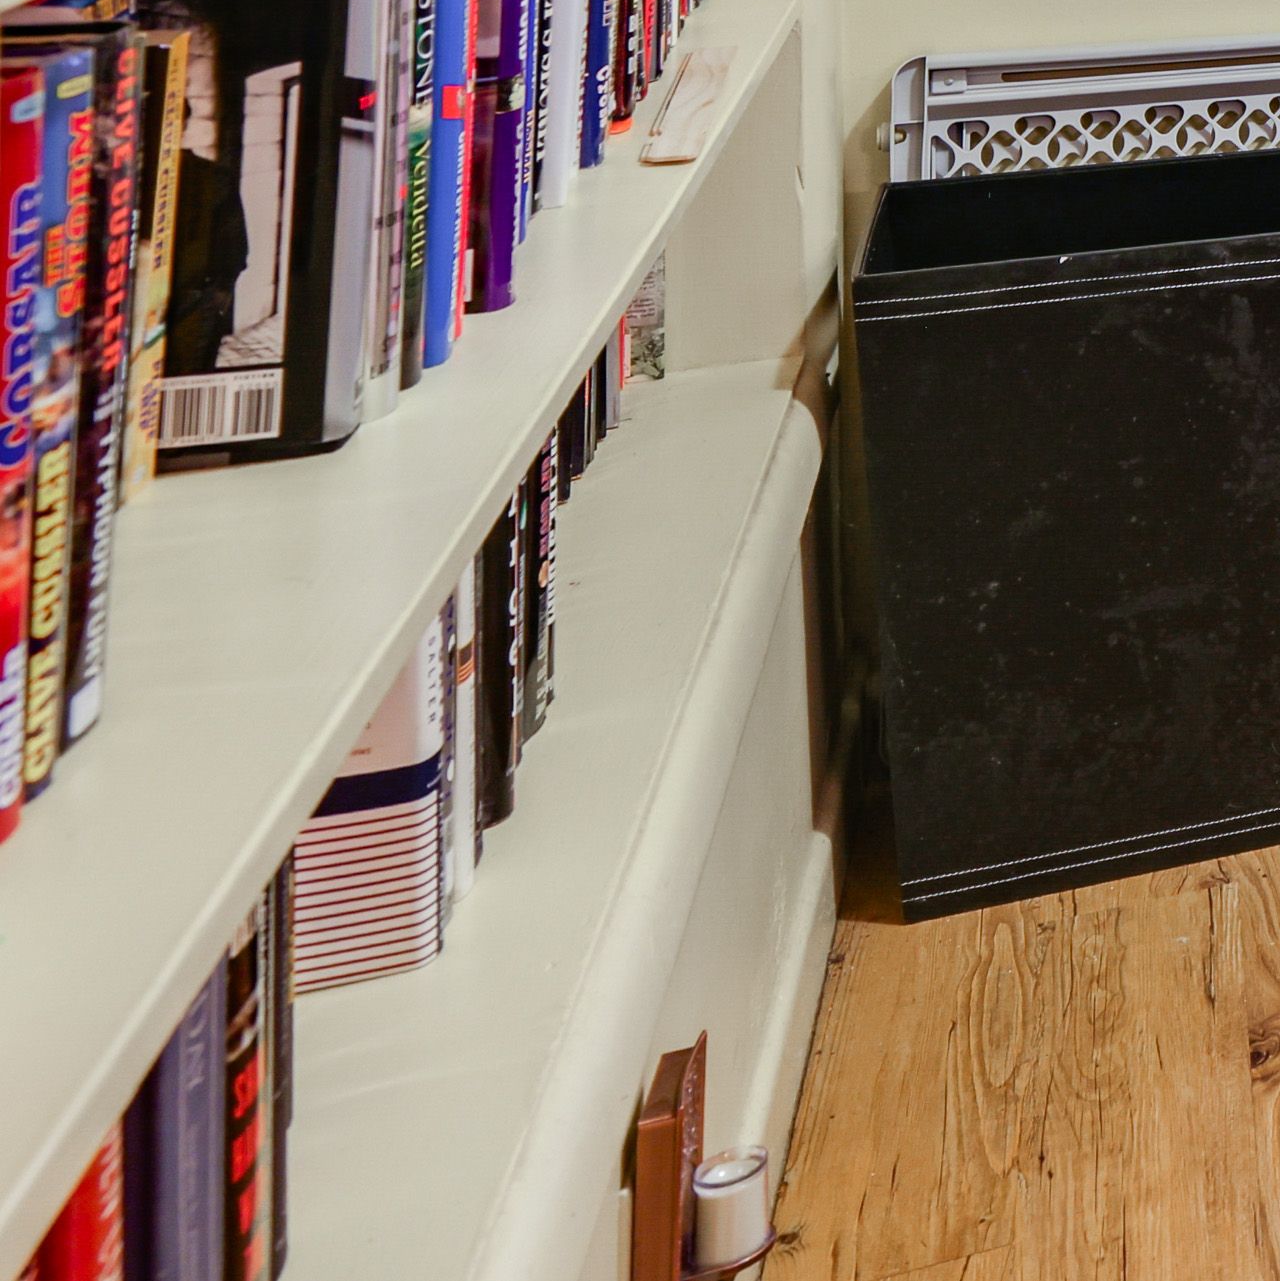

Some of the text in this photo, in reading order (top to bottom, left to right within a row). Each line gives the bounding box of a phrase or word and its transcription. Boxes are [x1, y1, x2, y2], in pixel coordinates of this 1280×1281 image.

[112, 47, 138, 170] CLIVE
[410, 139, 433, 271] Vendetta
[101, 177, 133, 373] CUSSLER
[24, 441, 71, 785] CLIVE CUSSLER
[428, 633, 438, 724] SALTER
